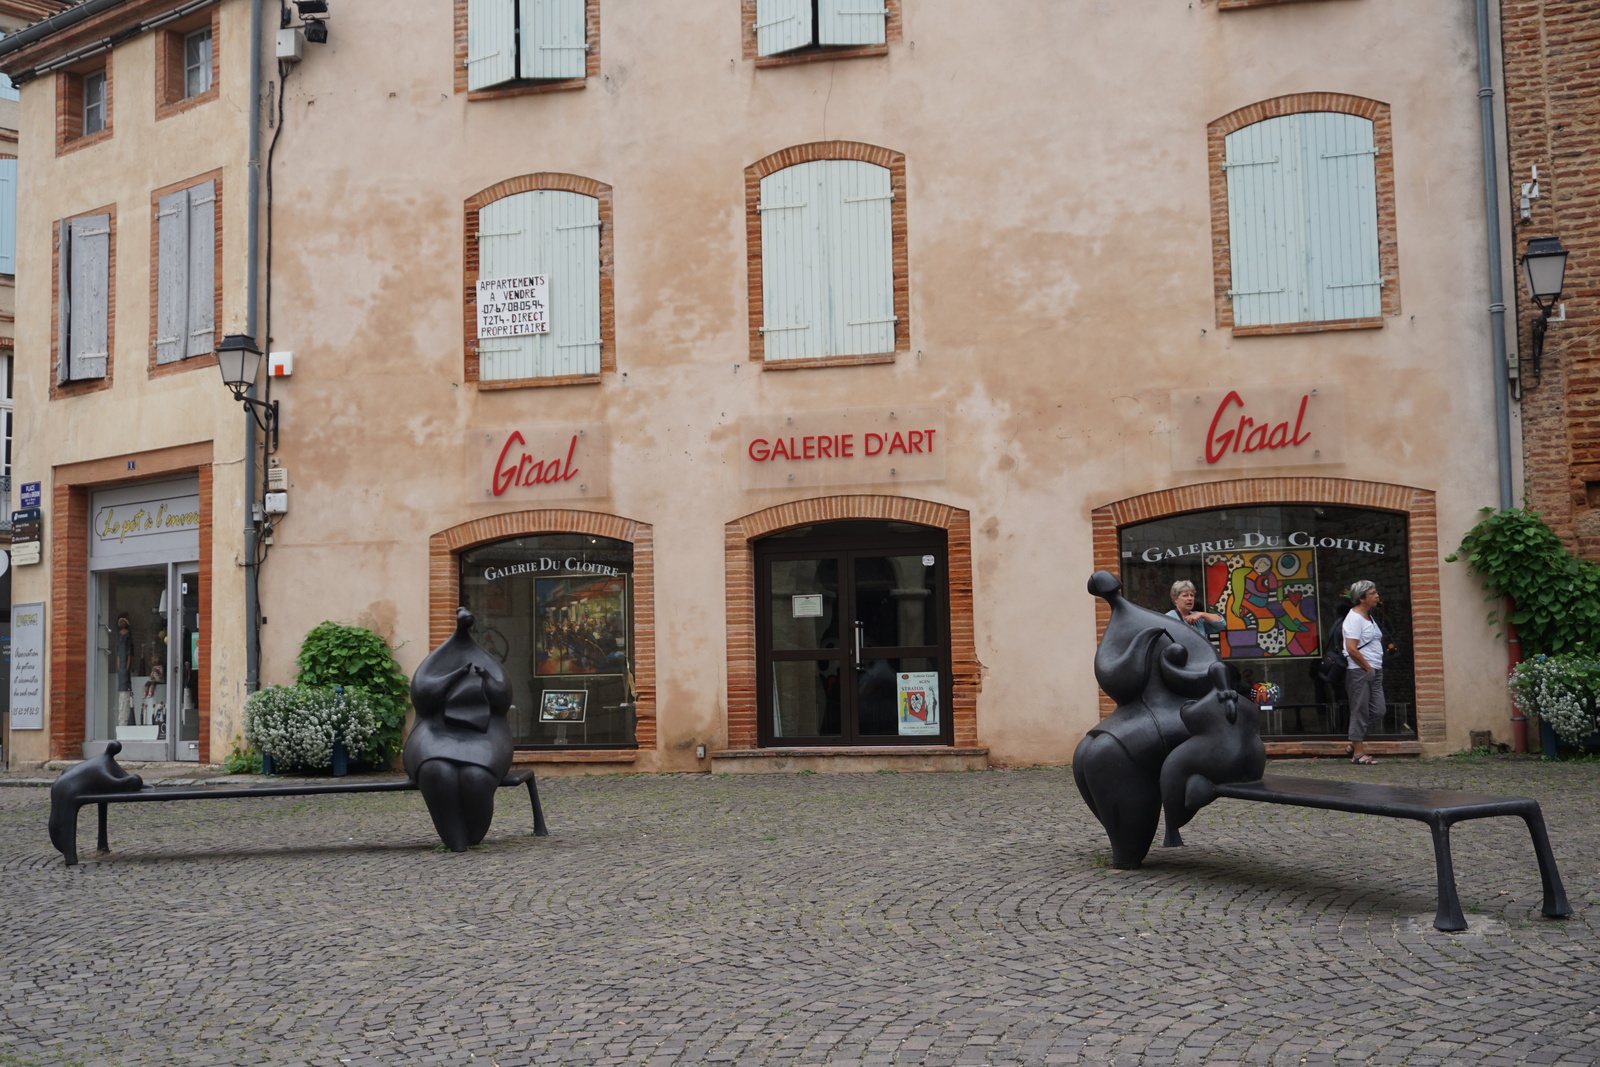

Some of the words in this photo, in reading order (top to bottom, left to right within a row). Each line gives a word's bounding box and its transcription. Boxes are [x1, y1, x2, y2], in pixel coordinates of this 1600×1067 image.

[480, 276, 545, 291] APPARTEMENTS
[490, 292, 495, 301] A
[503, 288, 536, 300] VENDRE
[481, 322, 546, 336] PROPRIETAIRE
[511, 311, 544, 323] DIRECT
[1205, 390, 1312, 464] Graal
[748, 434, 854, 462] GALERIE
[864, 429, 936, 456] D'ART
[492, 430, 579, 496] Graal
[102, 509, 120, 536] Le
[120, 509, 145, 544] pot
[1142, 538, 1236, 563] GALERIE
[1287, 531, 1386, 555] CLOITRE
[484, 562, 538, 581] GALERIE
[564, 556, 619, 578] CLOITRE
